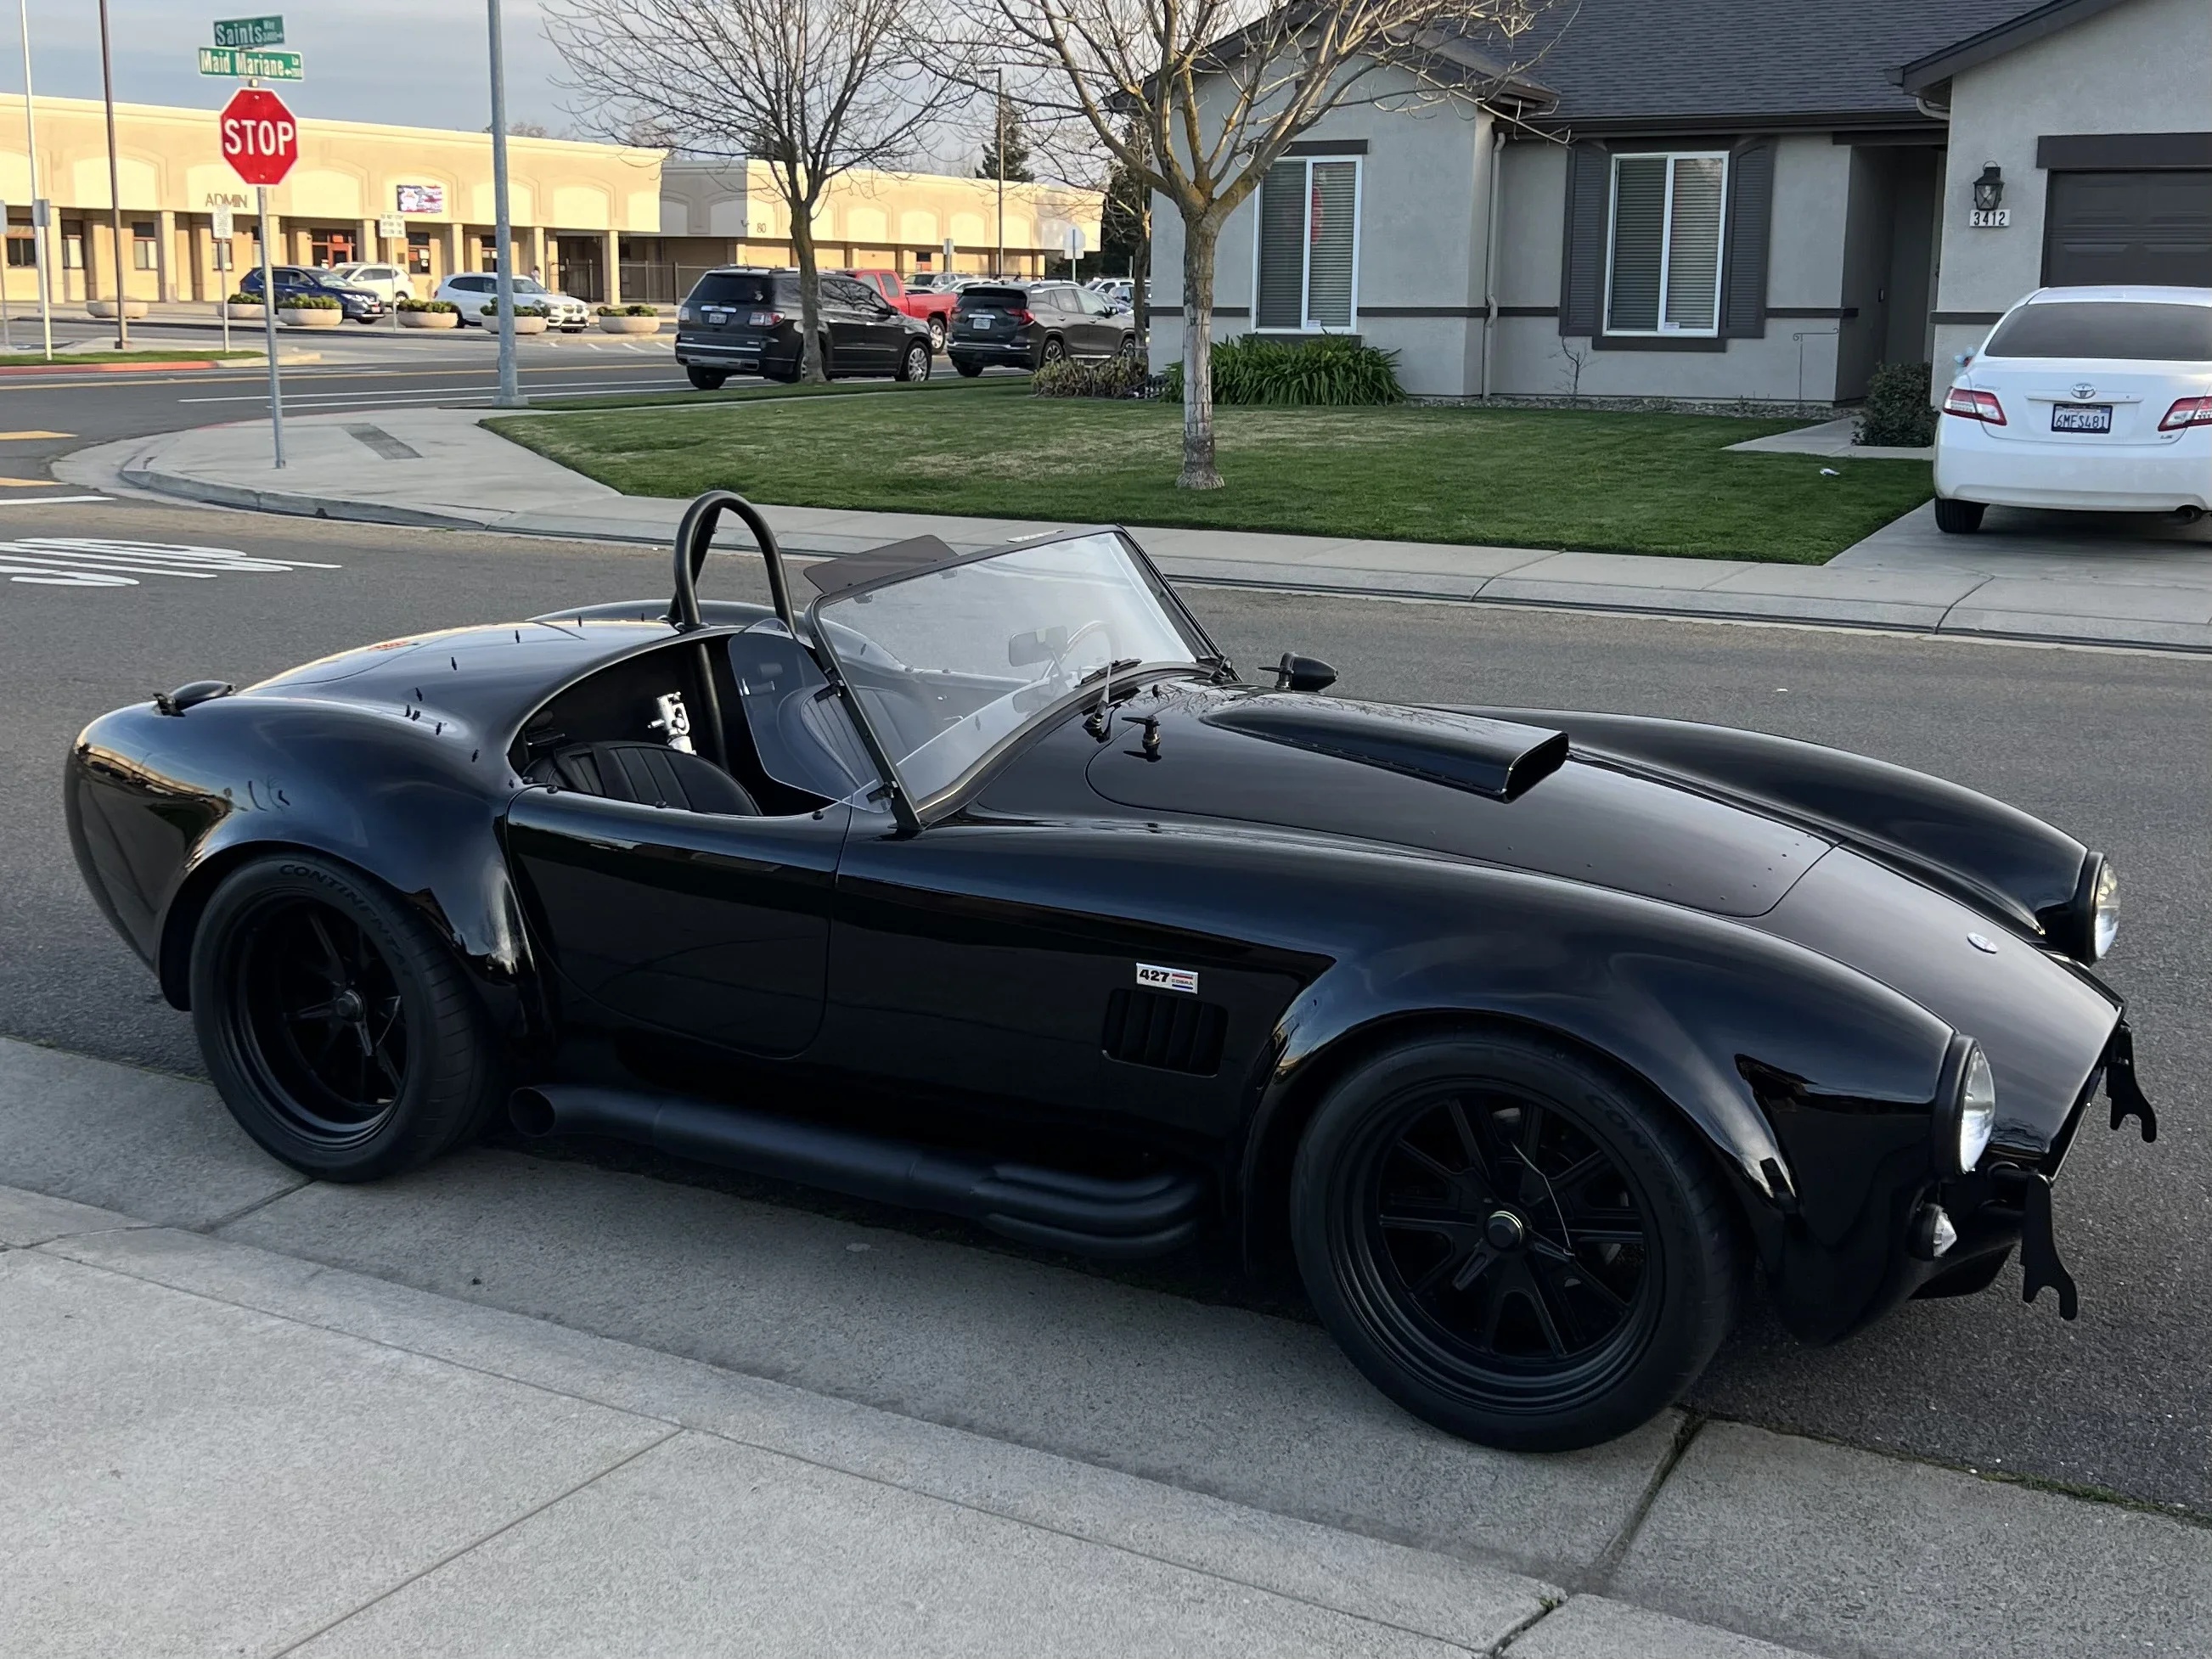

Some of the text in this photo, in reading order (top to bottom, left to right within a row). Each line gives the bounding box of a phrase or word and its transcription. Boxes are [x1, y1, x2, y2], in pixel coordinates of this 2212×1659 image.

[216, 23, 262, 46] Saints
[200, 50, 232, 74] Maid
[235, 52, 284, 76] Mariane
[224, 118, 294, 156] STOP
[205, 193, 248, 208] ADMIN
[1973, 211, 2006, 226] 3412
[757, 222, 767, 233] 80
[1140, 969, 1170, 982] 427
